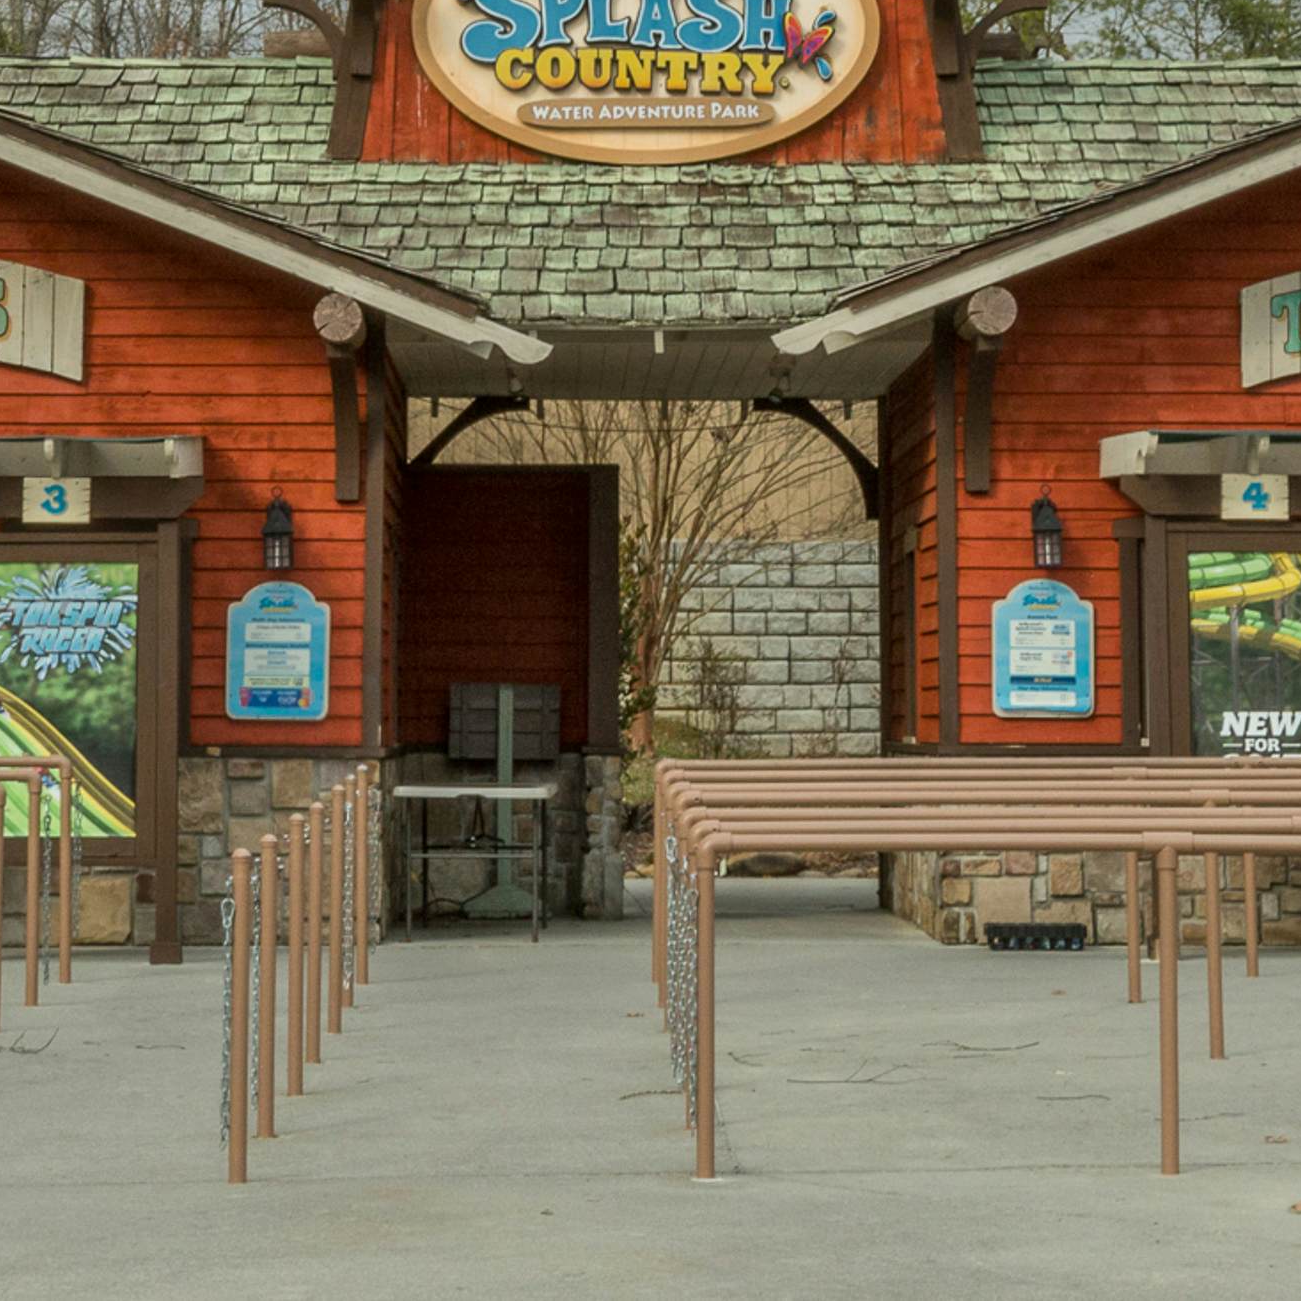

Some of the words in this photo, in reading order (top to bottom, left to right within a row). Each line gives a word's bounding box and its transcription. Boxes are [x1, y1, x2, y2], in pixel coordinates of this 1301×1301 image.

[496, 48, 785, 94] COUNTRY
[533, 106, 594, 119] WATER
[599, 104, 705, 119] ADVENTURE
[710, 102, 759, 118] PARK
[40, 484, 68, 514] 3
[1242, 481, 1271, 511] 4
[1244, 738, 1280, 752] FOR
